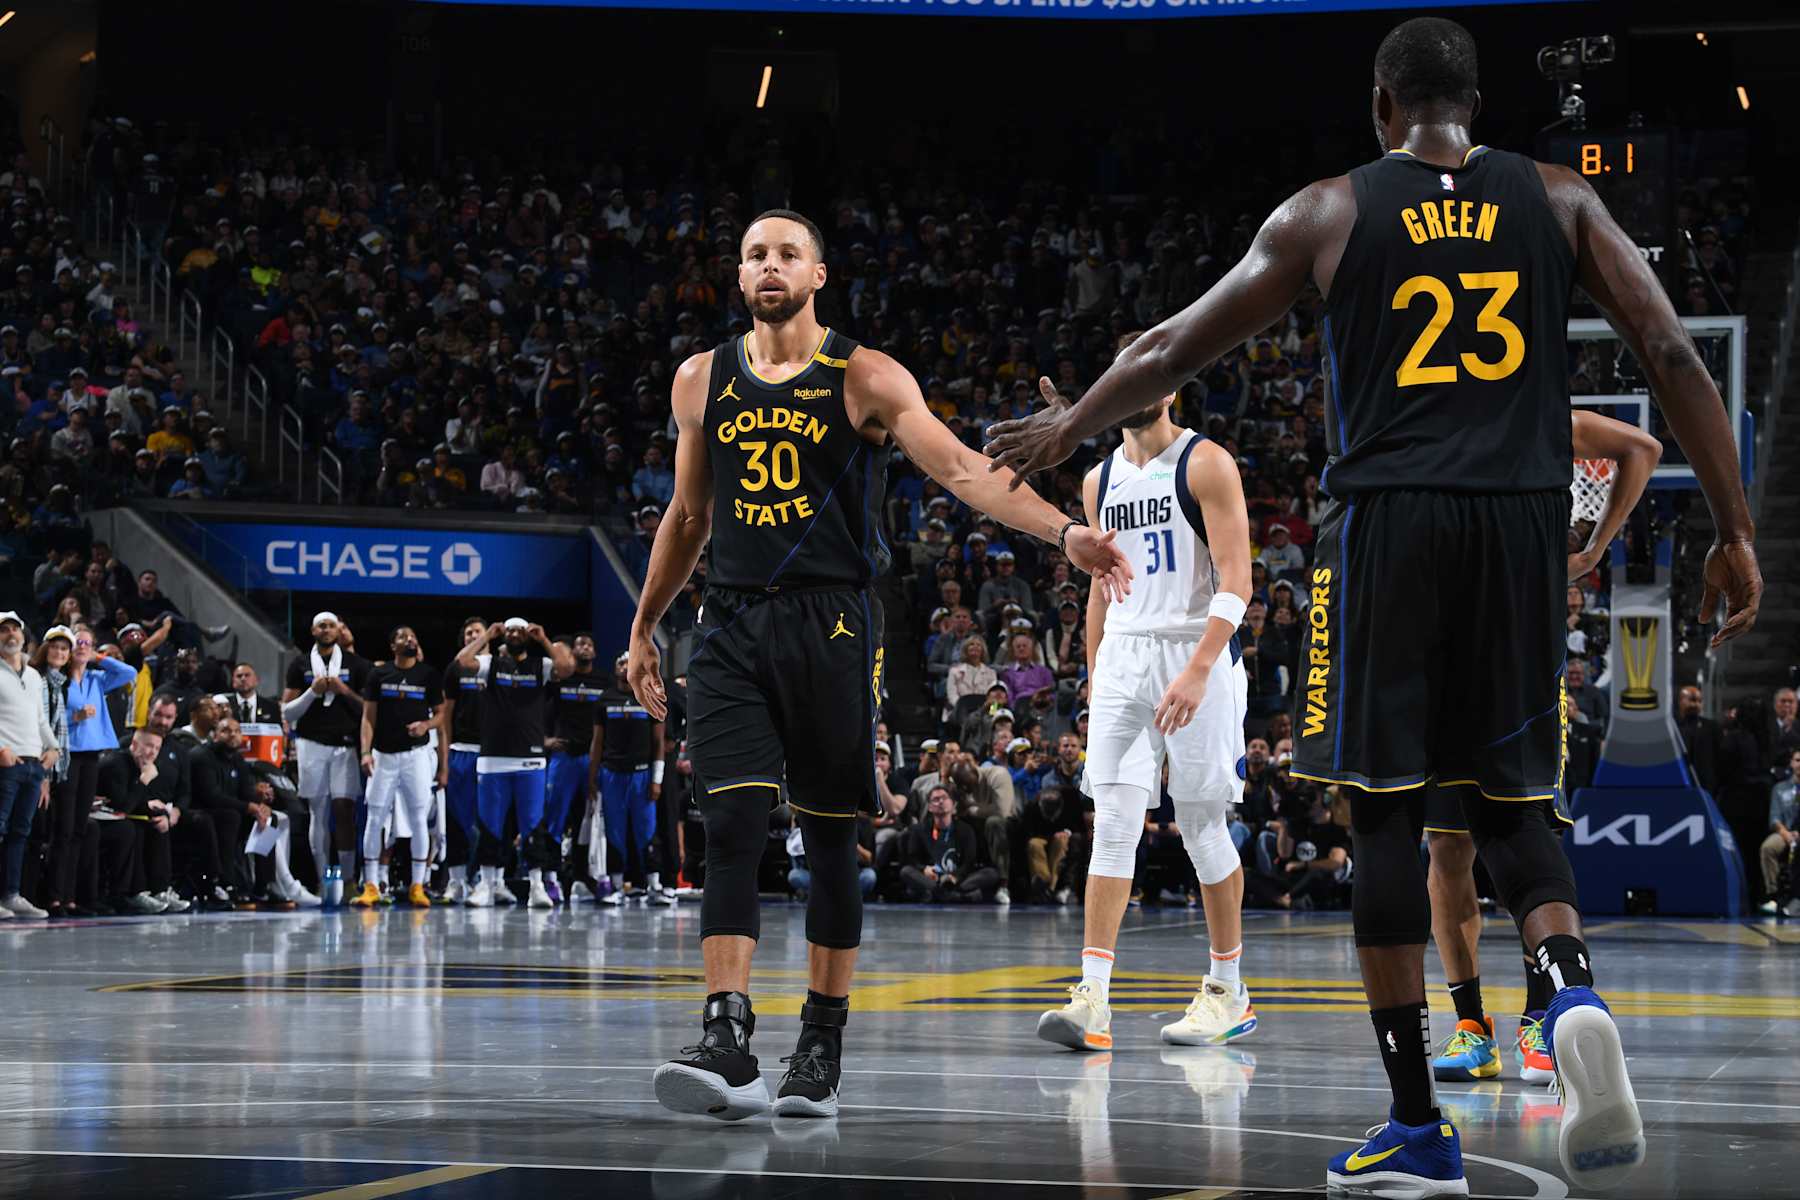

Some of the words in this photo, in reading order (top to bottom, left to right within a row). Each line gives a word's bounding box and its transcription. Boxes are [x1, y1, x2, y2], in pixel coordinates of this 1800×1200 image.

[1581, 143, 1633, 175] 8.1
[1402, 200, 1500, 244] GREEN
[1391, 270, 1526, 388] 23
[793, 388, 832, 400] Rakuten
[717, 408, 829, 444] GOLDEN
[738, 440, 801, 492] 30
[735, 495, 814, 527] STATE
[1105, 495, 1172, 532] DALLAS
[266, 541, 430, 578] CHASE
[1143, 530, 1177, 576] 31
[1302, 567, 1331, 737] WARRIORS
[1573, 814, 1705, 846] KIA
